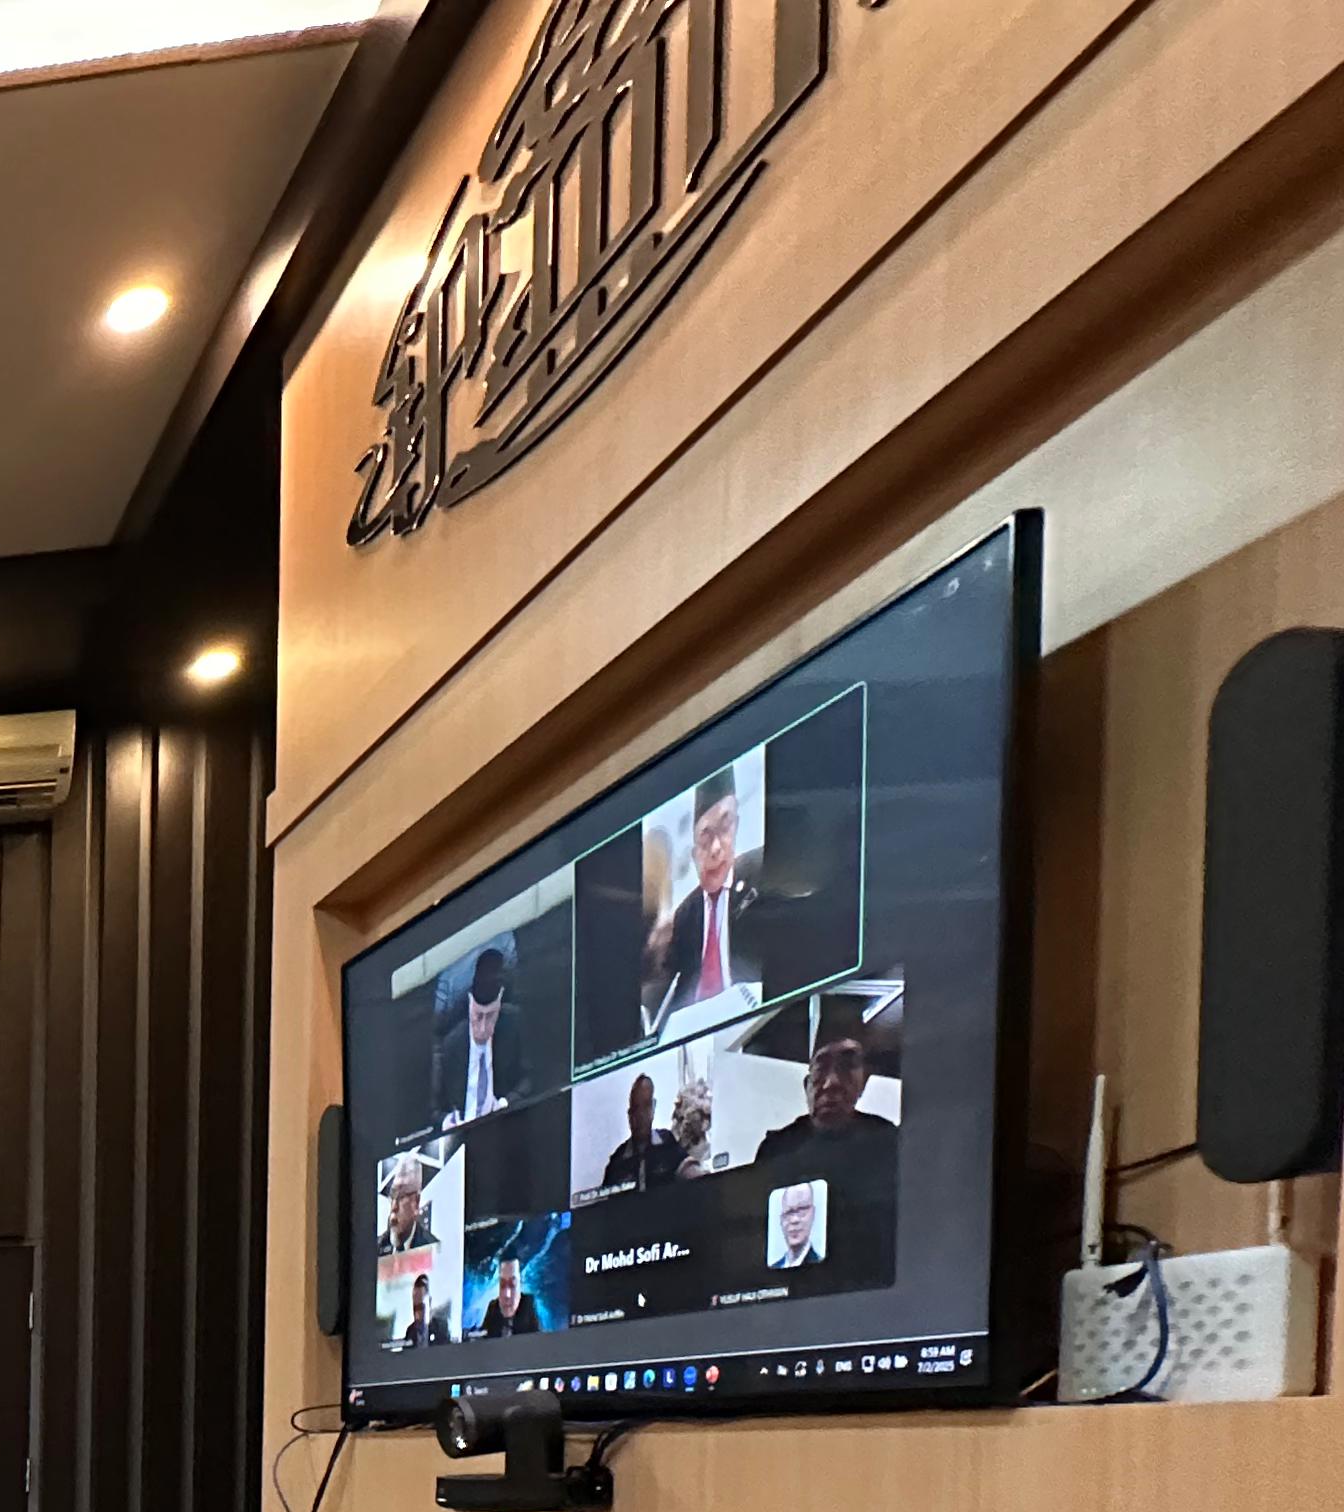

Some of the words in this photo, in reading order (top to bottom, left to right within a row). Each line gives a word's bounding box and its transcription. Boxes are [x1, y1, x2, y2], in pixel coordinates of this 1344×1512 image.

[585, 1256, 599, 1274] Dr
[601, 1248, 635, 1271] Mohd
[636, 1243, 660, 1264] Sofi
